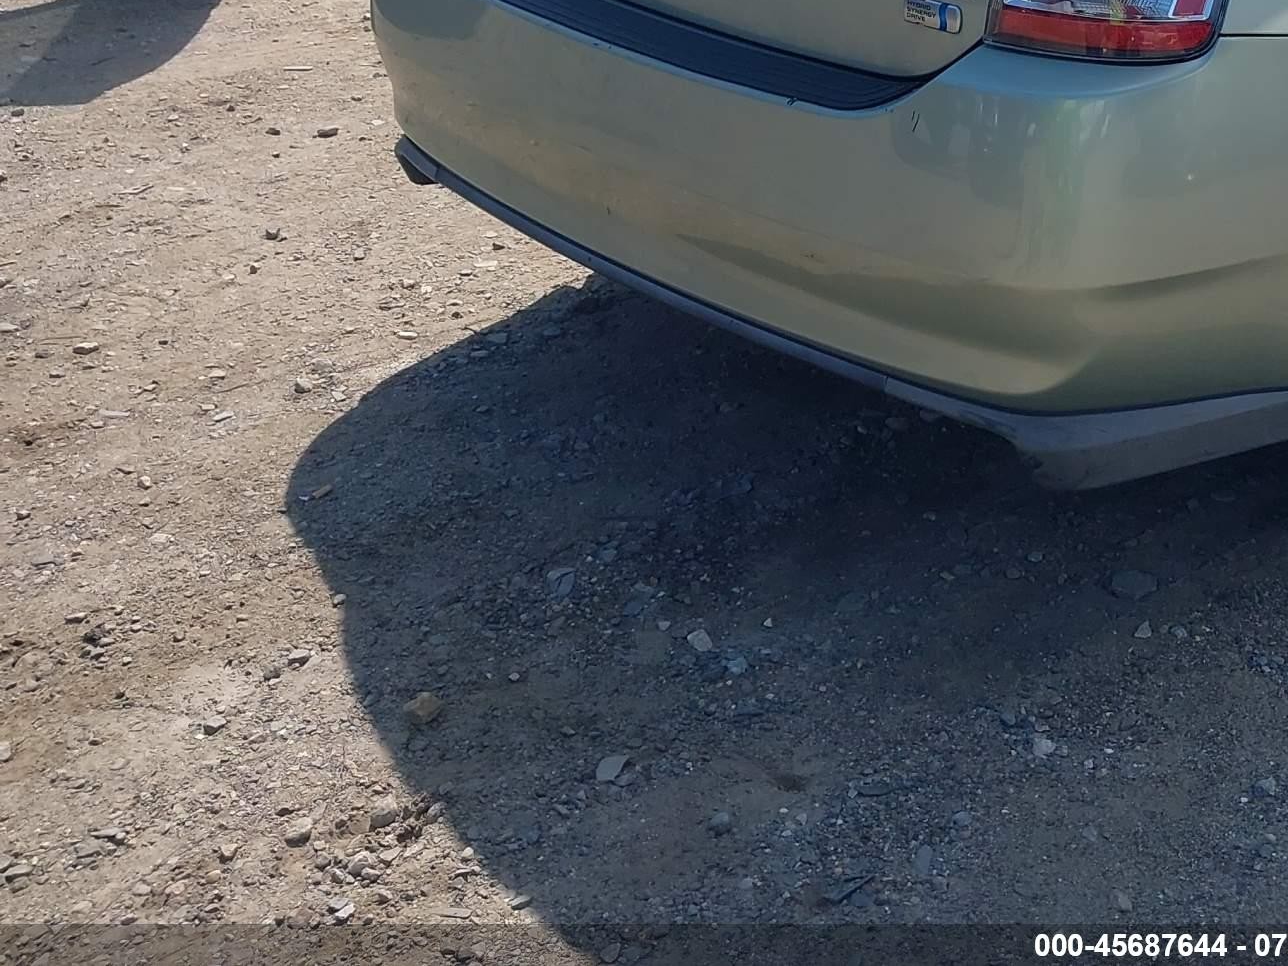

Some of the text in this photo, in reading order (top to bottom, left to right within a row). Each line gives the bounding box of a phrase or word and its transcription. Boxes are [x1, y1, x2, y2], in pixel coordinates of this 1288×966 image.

[907, 0, 932, 11] HYBRID
[906, 6, 937, 19] SYNERGY
[906, 12, 926, 22] DRIVE
